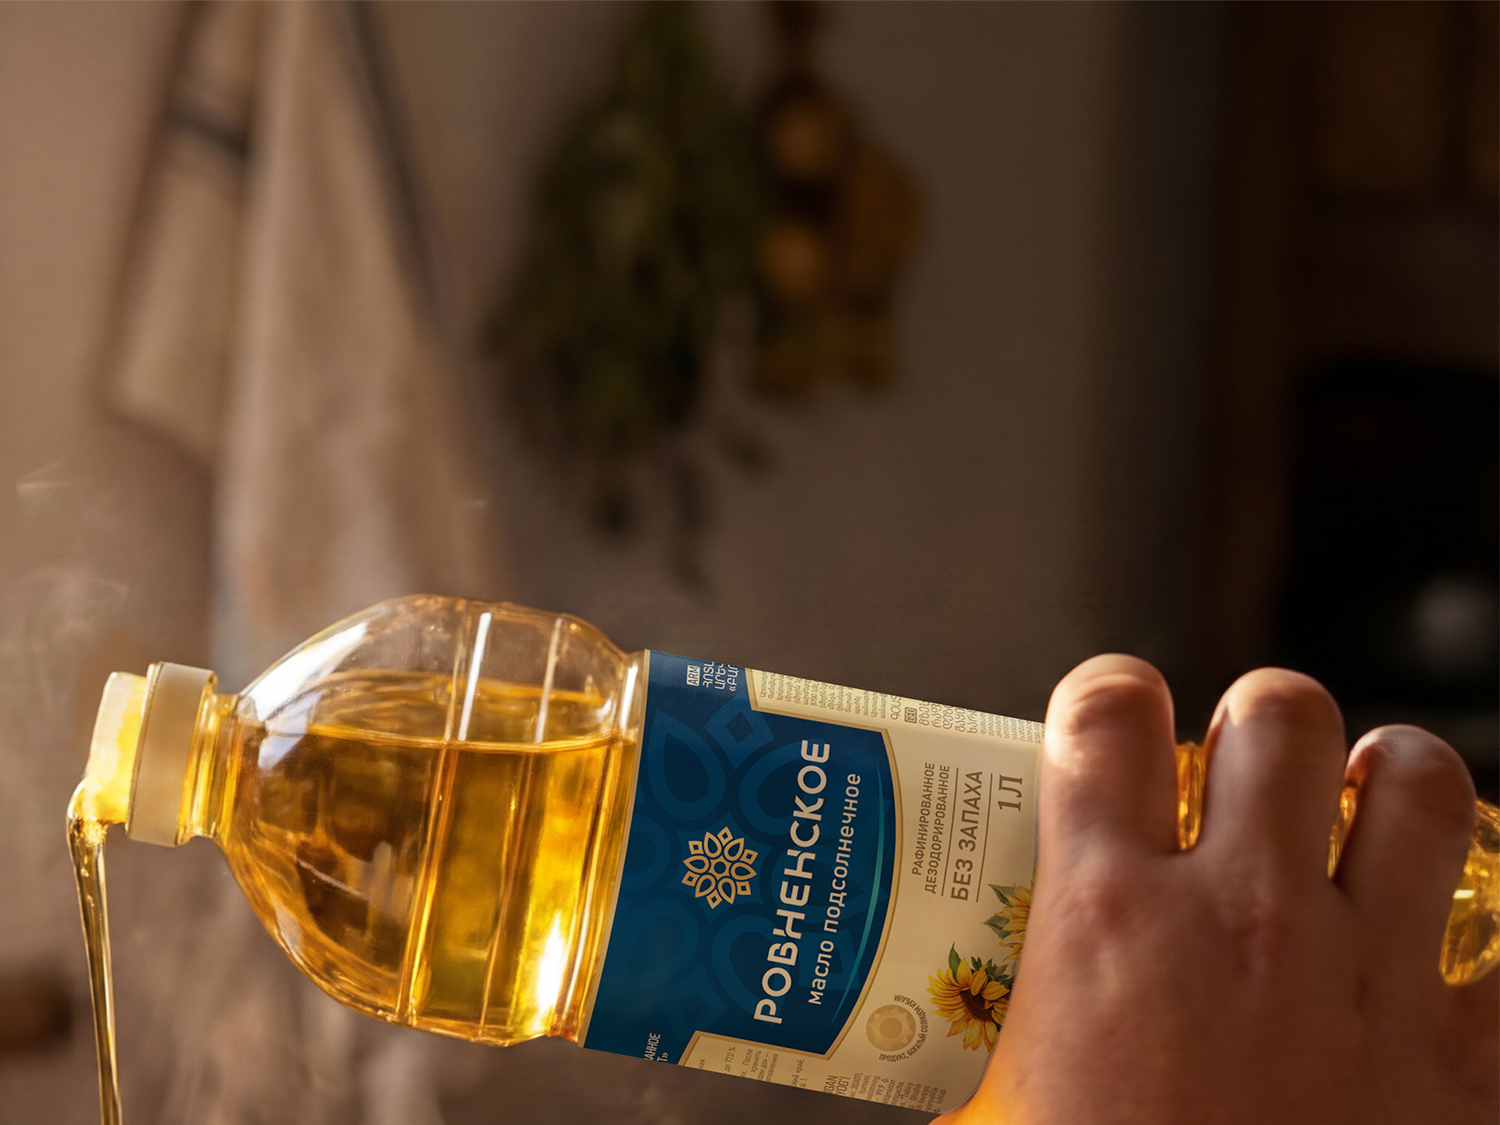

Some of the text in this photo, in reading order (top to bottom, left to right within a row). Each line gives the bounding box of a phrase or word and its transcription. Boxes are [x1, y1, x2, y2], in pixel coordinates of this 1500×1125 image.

[687, 665, 700, 686] ARM
[904, 707, 917, 723] GEO
[911, 762, 935, 876] РАФИНИРОВАННОЕ
[924, 765, 950, 894] ДЕЗОДОРИРОВАННОЕ
[950, 771, 983, 901] БЕЗ ЗАПАХА
[753, 739, 831, 1025] РОВНЕНСКОЕ
[808, 773, 861, 1006] масло подсолнечное
[893, 994, 918, 1009] КУБАНИ
[914, 1005, 928, 1033] СОЛНЦЕМ
[878, 1053, 909, 1063] ПРОДУКТ,
[906, 1033, 927, 1057] БОГАТЫЙ
